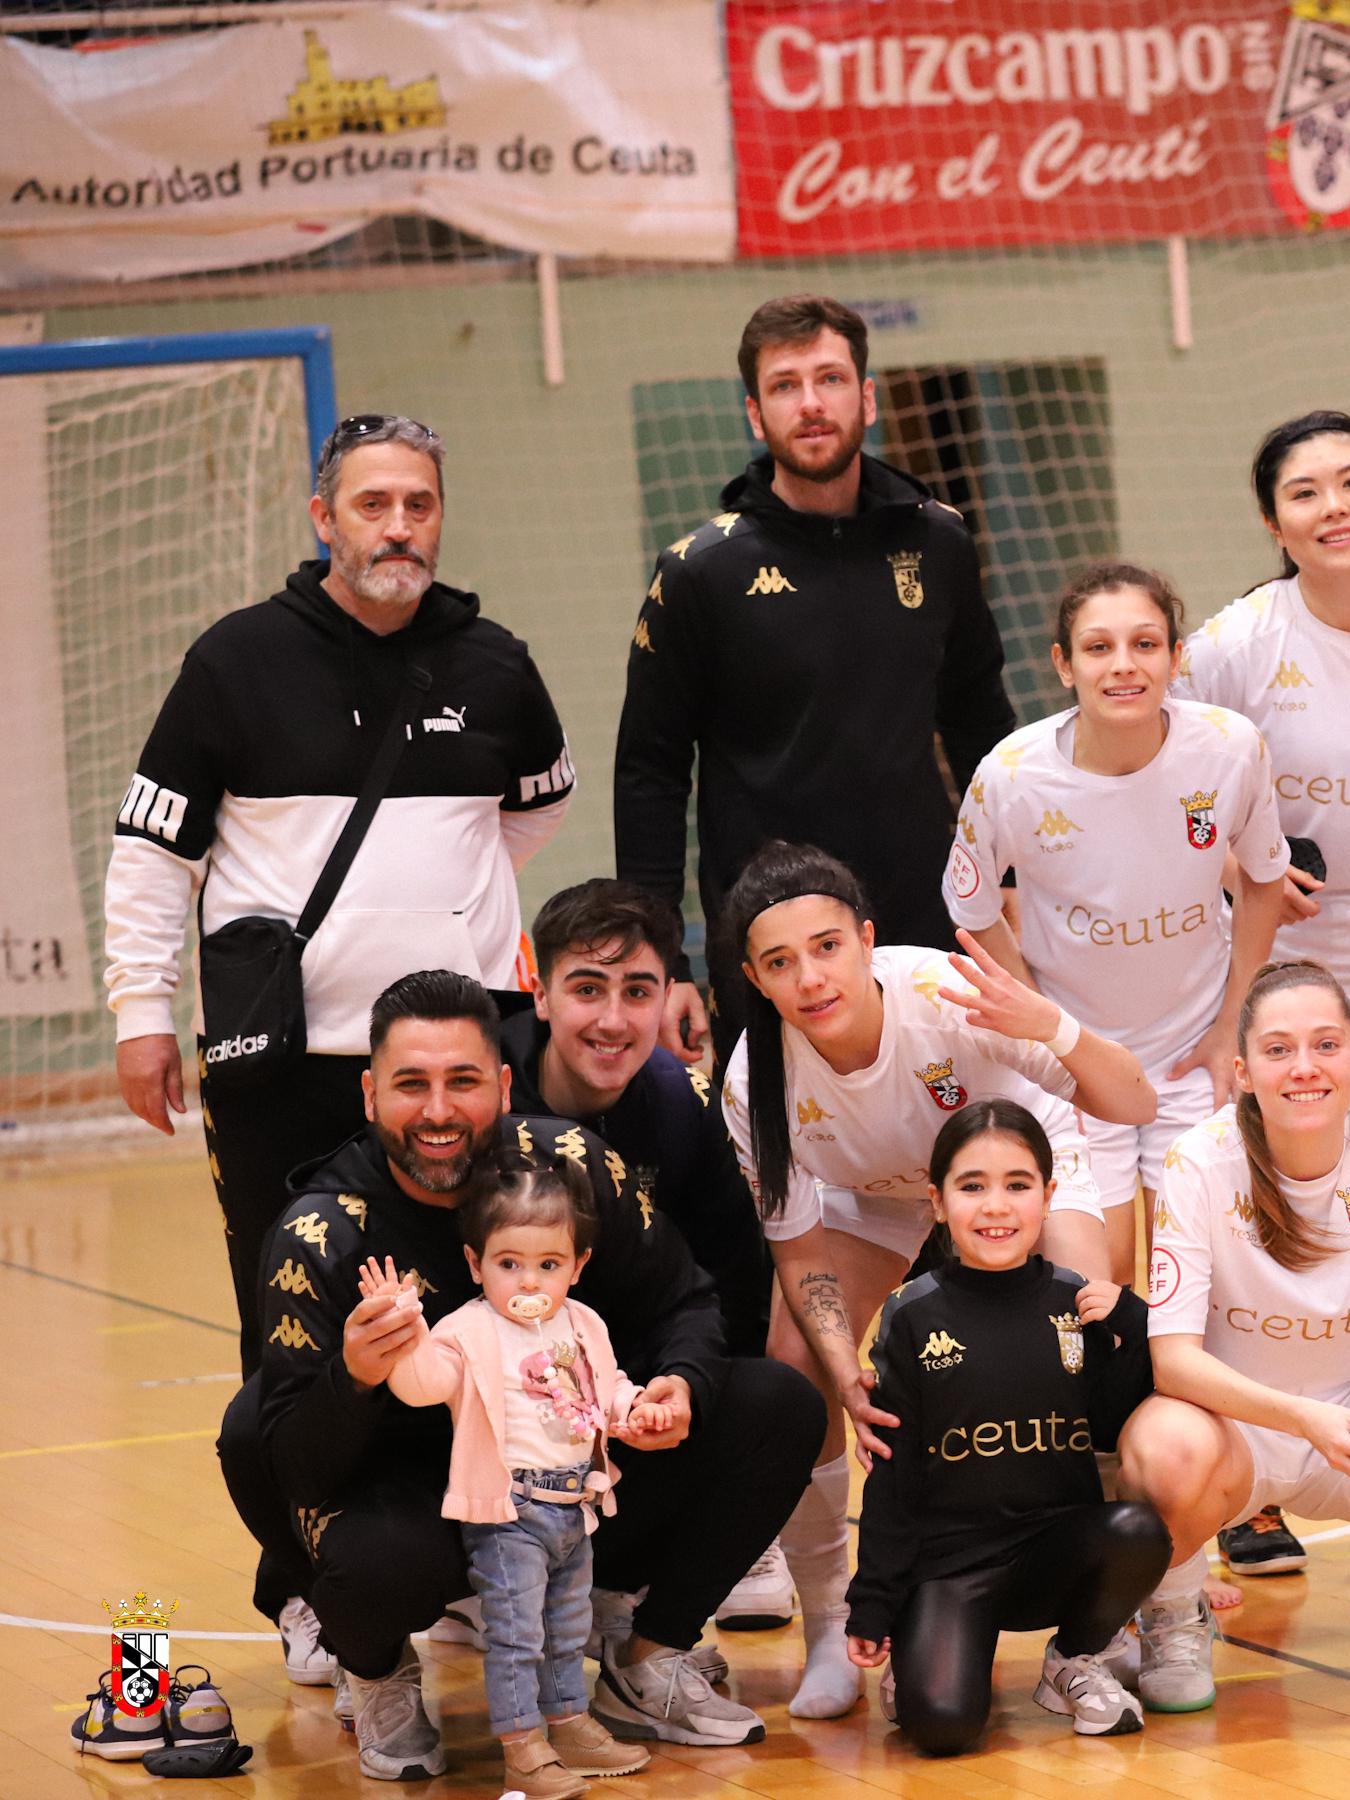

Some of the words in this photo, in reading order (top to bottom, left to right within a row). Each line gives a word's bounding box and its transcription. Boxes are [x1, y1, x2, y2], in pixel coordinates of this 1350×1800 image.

[753, 22, 1231, 115] Cruzcampo
[12, 159, 243, 210] Autoridad
[260, 134, 479, 187] Portuaria
[497, 135, 553, 176] de
[571, 137, 697, 178] Ceuta
[778, 139, 917, 223] Con
[937, 133, 1000, 198] el
[423, 718, 461, 733] PUMA
[206, 1033, 269, 1064] adidas
